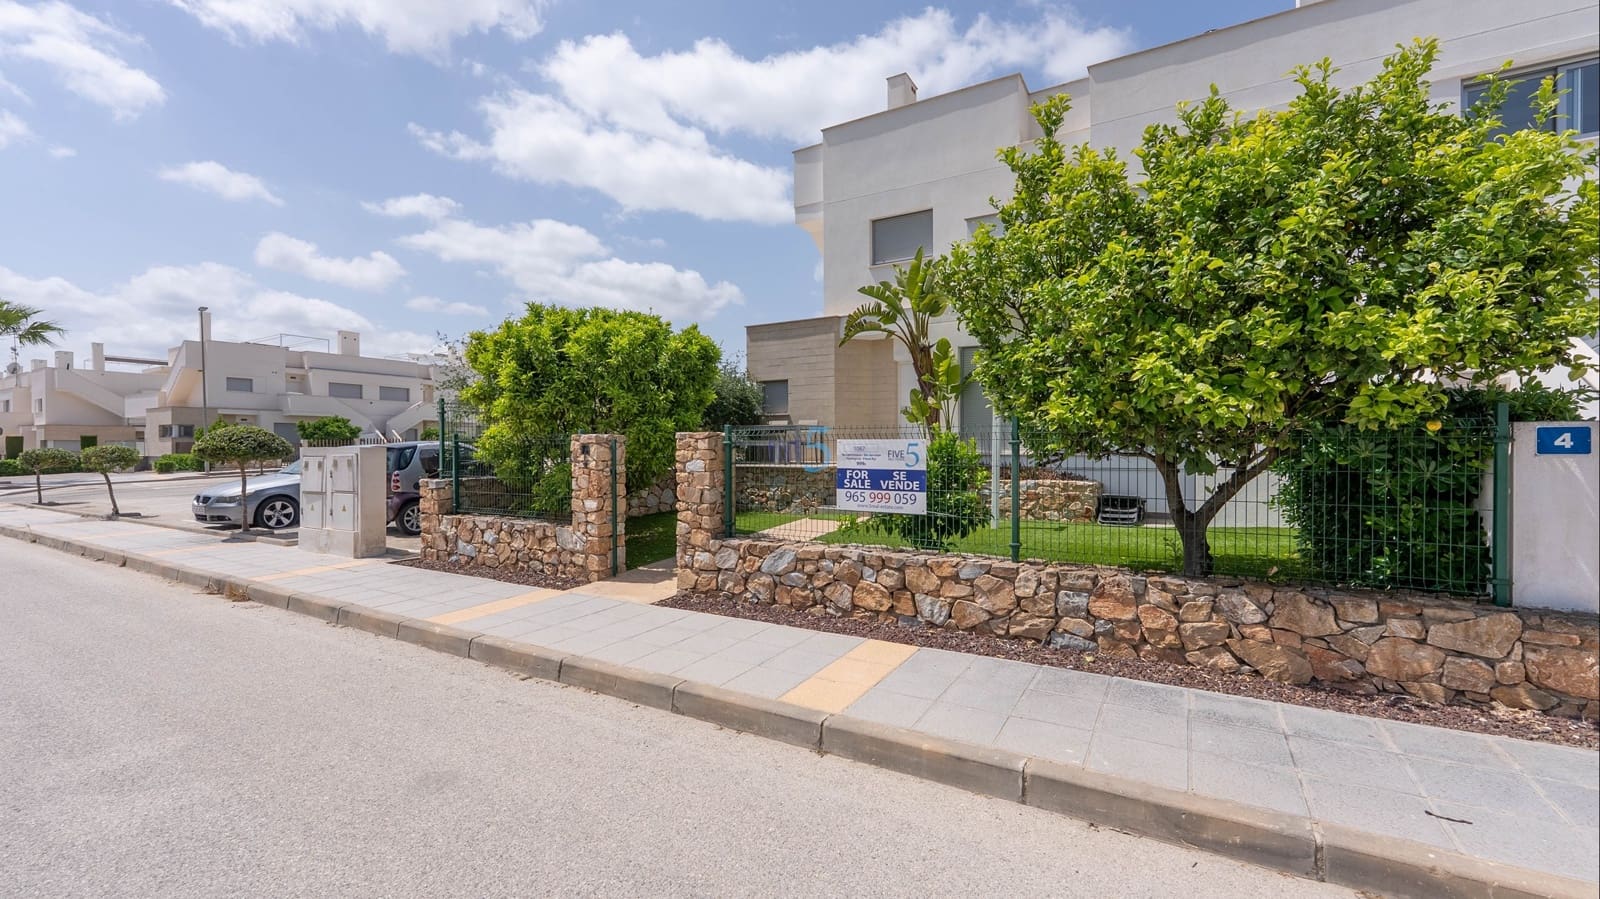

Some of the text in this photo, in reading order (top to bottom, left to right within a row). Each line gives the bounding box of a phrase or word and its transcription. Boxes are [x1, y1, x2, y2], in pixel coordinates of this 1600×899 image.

[1553, 432, 1574, 449] 4
[887, 442, 920, 468] FIVE 5
[846, 469, 869, 480] FOR
[892, 470, 907, 481] SE
[843, 479, 871, 489] SALE
[880, 480, 920, 491] VENDE
[845, 491, 917, 505] 965 999 059
